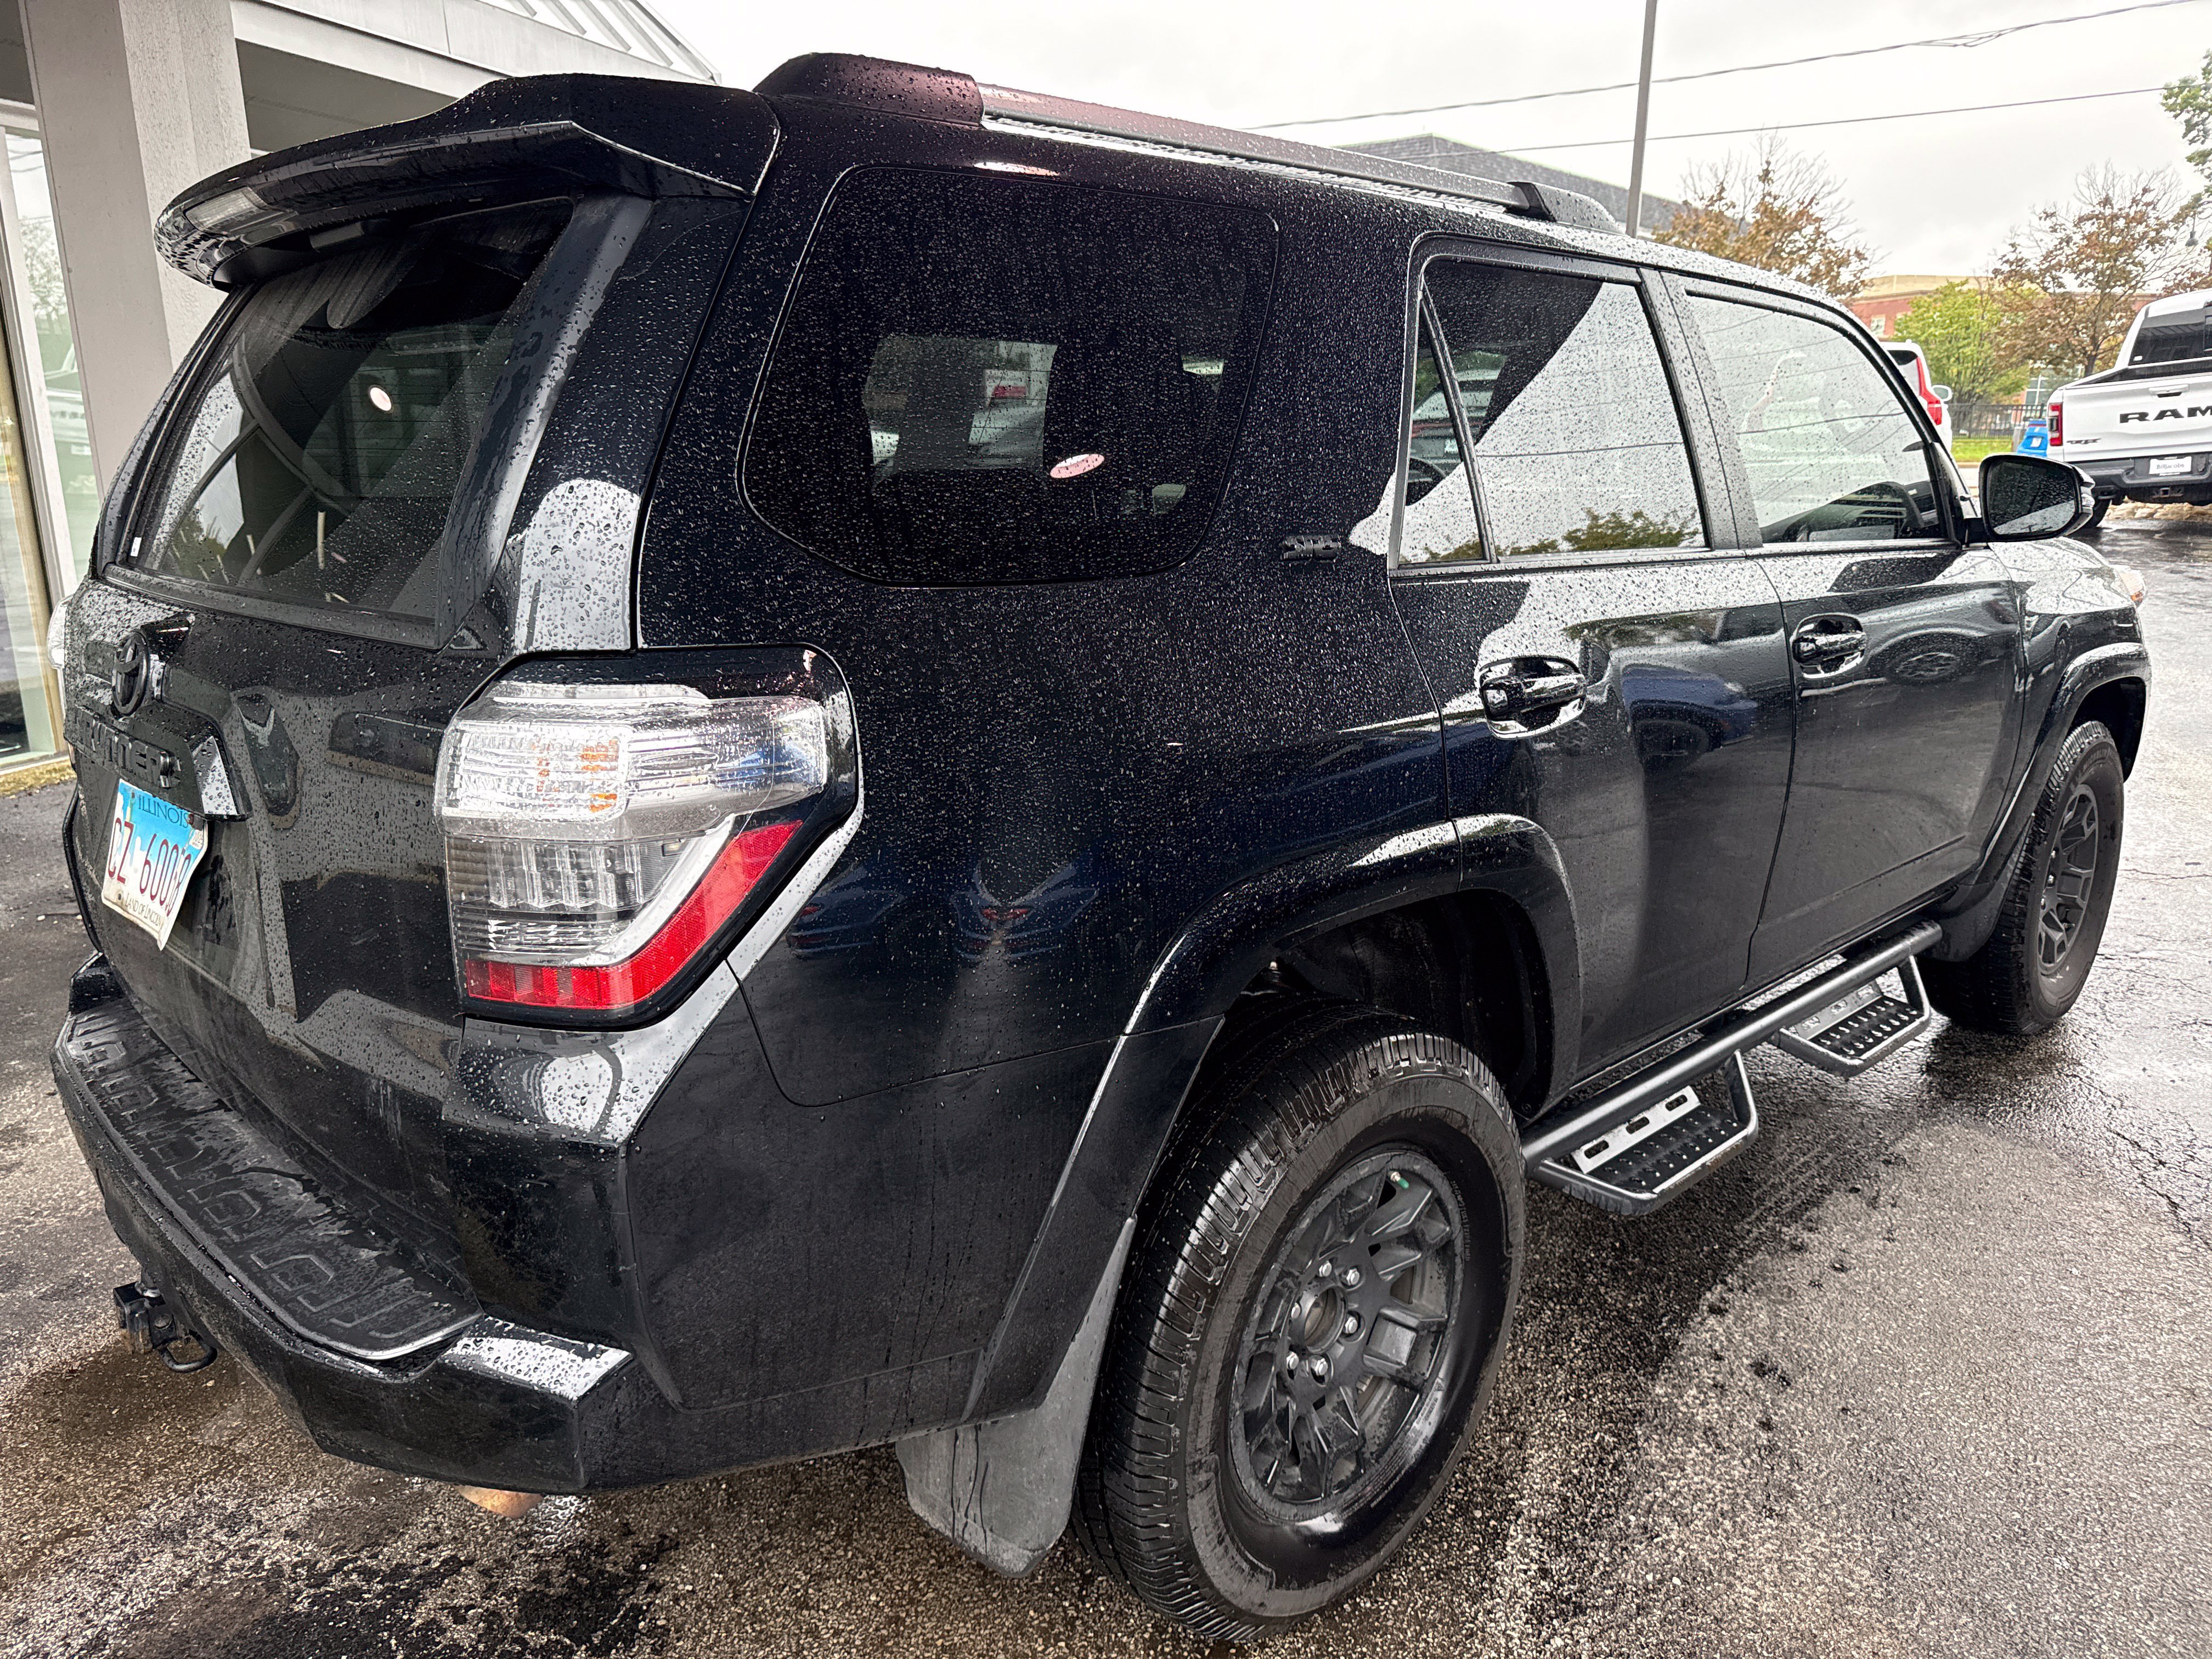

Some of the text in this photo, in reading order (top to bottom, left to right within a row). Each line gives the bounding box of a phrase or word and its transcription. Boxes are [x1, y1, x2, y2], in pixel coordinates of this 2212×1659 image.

[2120, 405, 2212, 423] RAM
[138, 795, 189, 828] ILLINOIS
[108, 817, 134, 884] CZ
